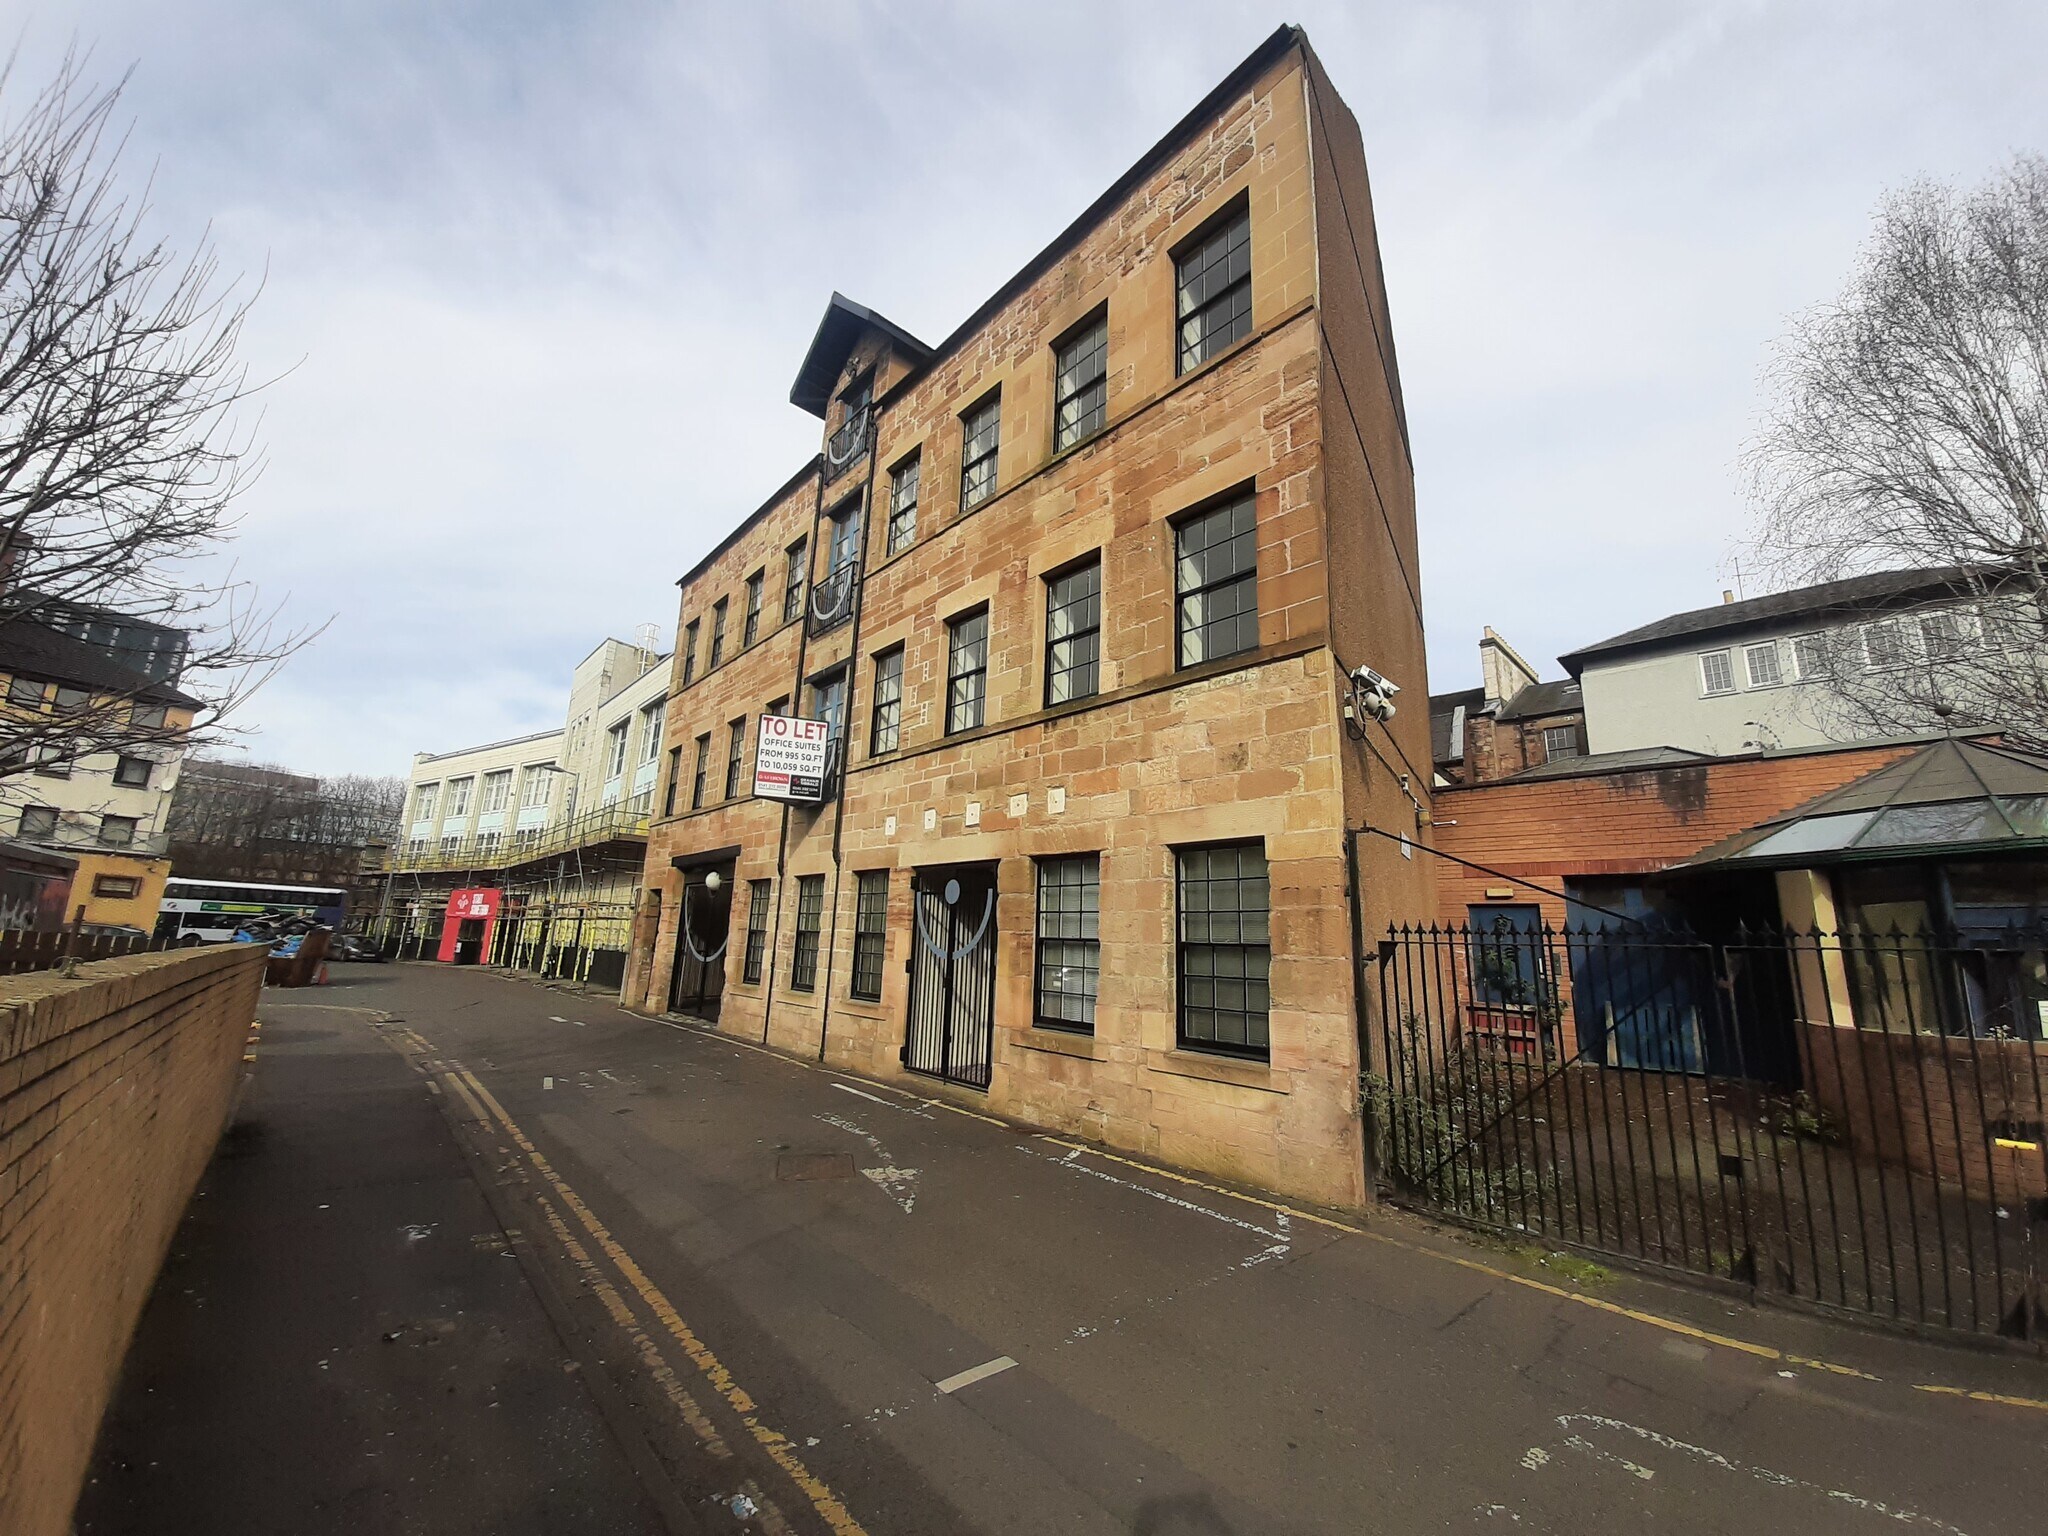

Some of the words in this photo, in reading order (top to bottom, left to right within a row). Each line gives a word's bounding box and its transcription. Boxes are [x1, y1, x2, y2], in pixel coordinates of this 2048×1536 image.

[763, 717, 787, 736] TO
[793, 721, 826, 740] LET
[764, 738, 793, 748] OFFICE
[794, 741, 821, 751] SUITES
[760, 749, 783, 758] FROM
[785, 751, 799, 760] 995
[801, 753, 823, 762] SQ.FT
[760, 760, 770, 768] TO
[773, 761, 797, 771] 10,059
[799, 764, 821, 773] SQ.FT
